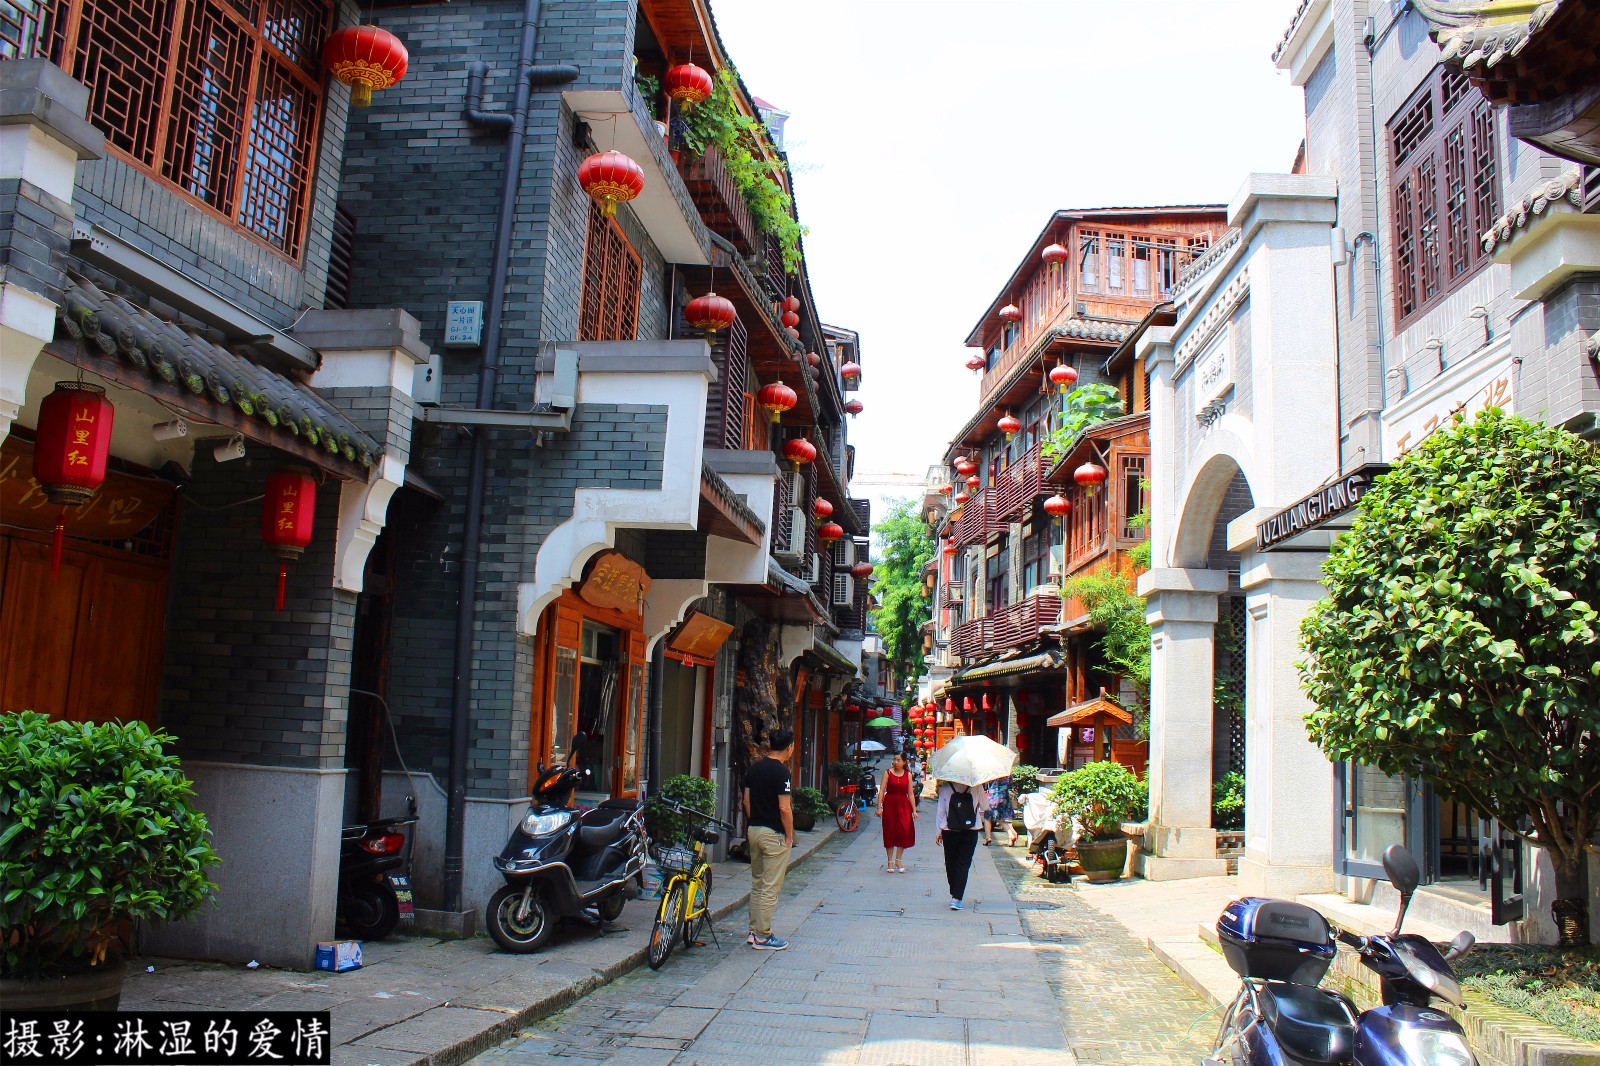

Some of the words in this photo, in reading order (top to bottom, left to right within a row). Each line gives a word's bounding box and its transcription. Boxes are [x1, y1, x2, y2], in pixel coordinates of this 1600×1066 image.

[68, 408, 95, 466] 山里红
[277, 485, 298, 530] 山里红
